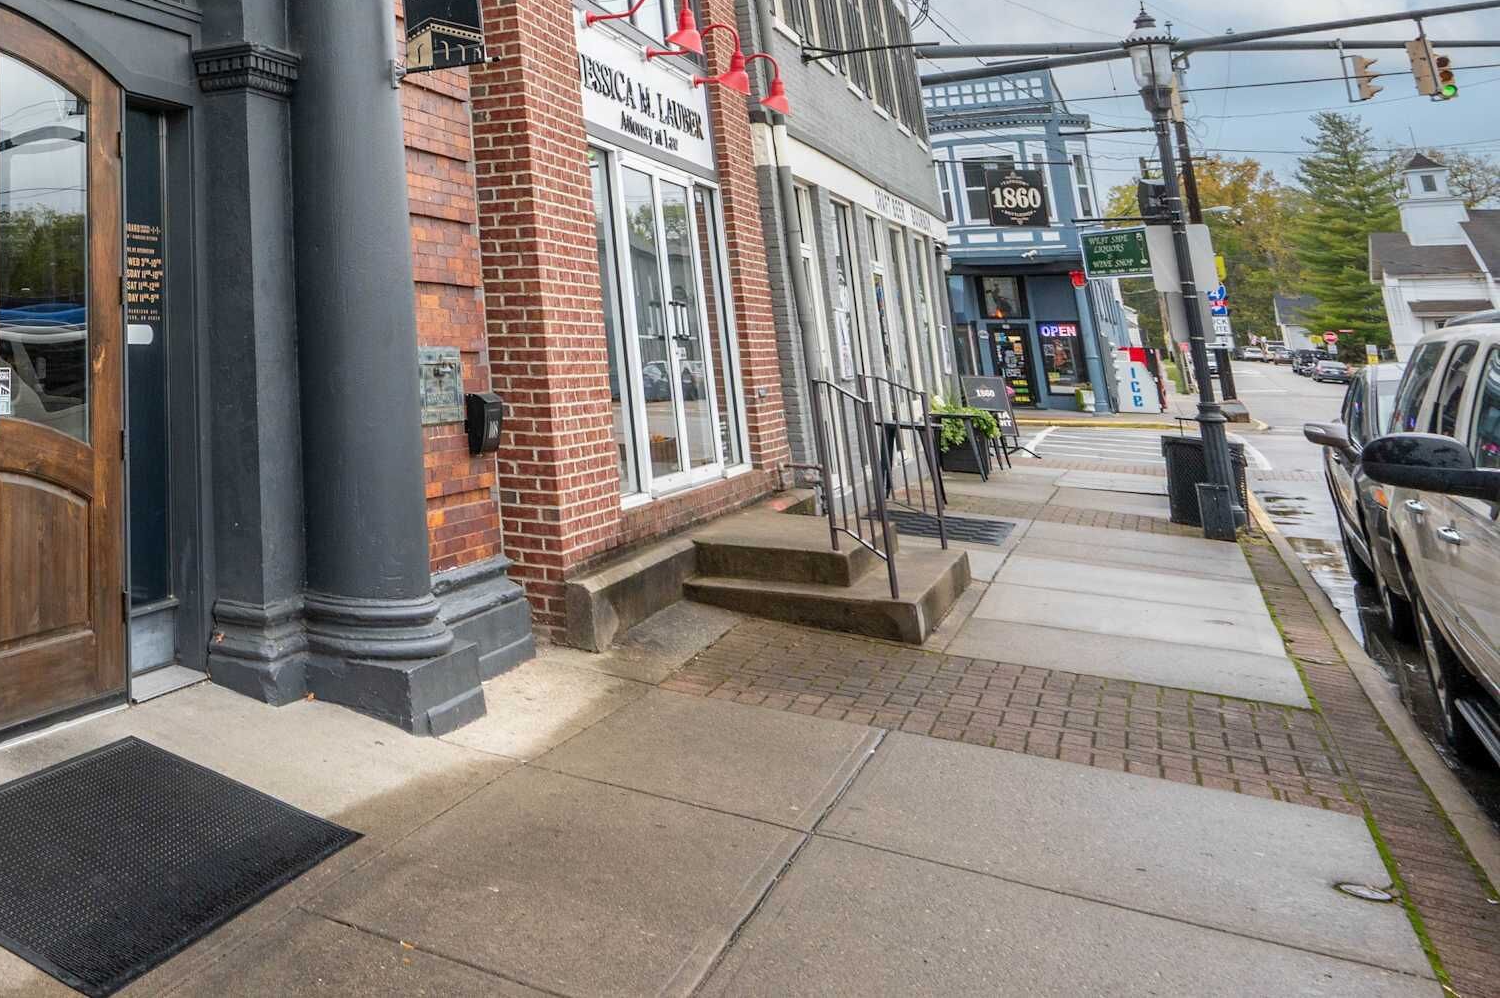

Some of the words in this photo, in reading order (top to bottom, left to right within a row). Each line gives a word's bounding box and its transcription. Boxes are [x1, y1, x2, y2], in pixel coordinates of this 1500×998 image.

[580, 54, 636, 110] ESSICA
[638, 82, 655, 120] M.
[991, 187, 1041, 209] 1860
[1111, 234, 1129, 243] SIDE
[1093, 243, 1125, 254] LIQUORS
[1041, 326, 1077, 337] OPEN
[1130, 366, 1144, 407] ICE
